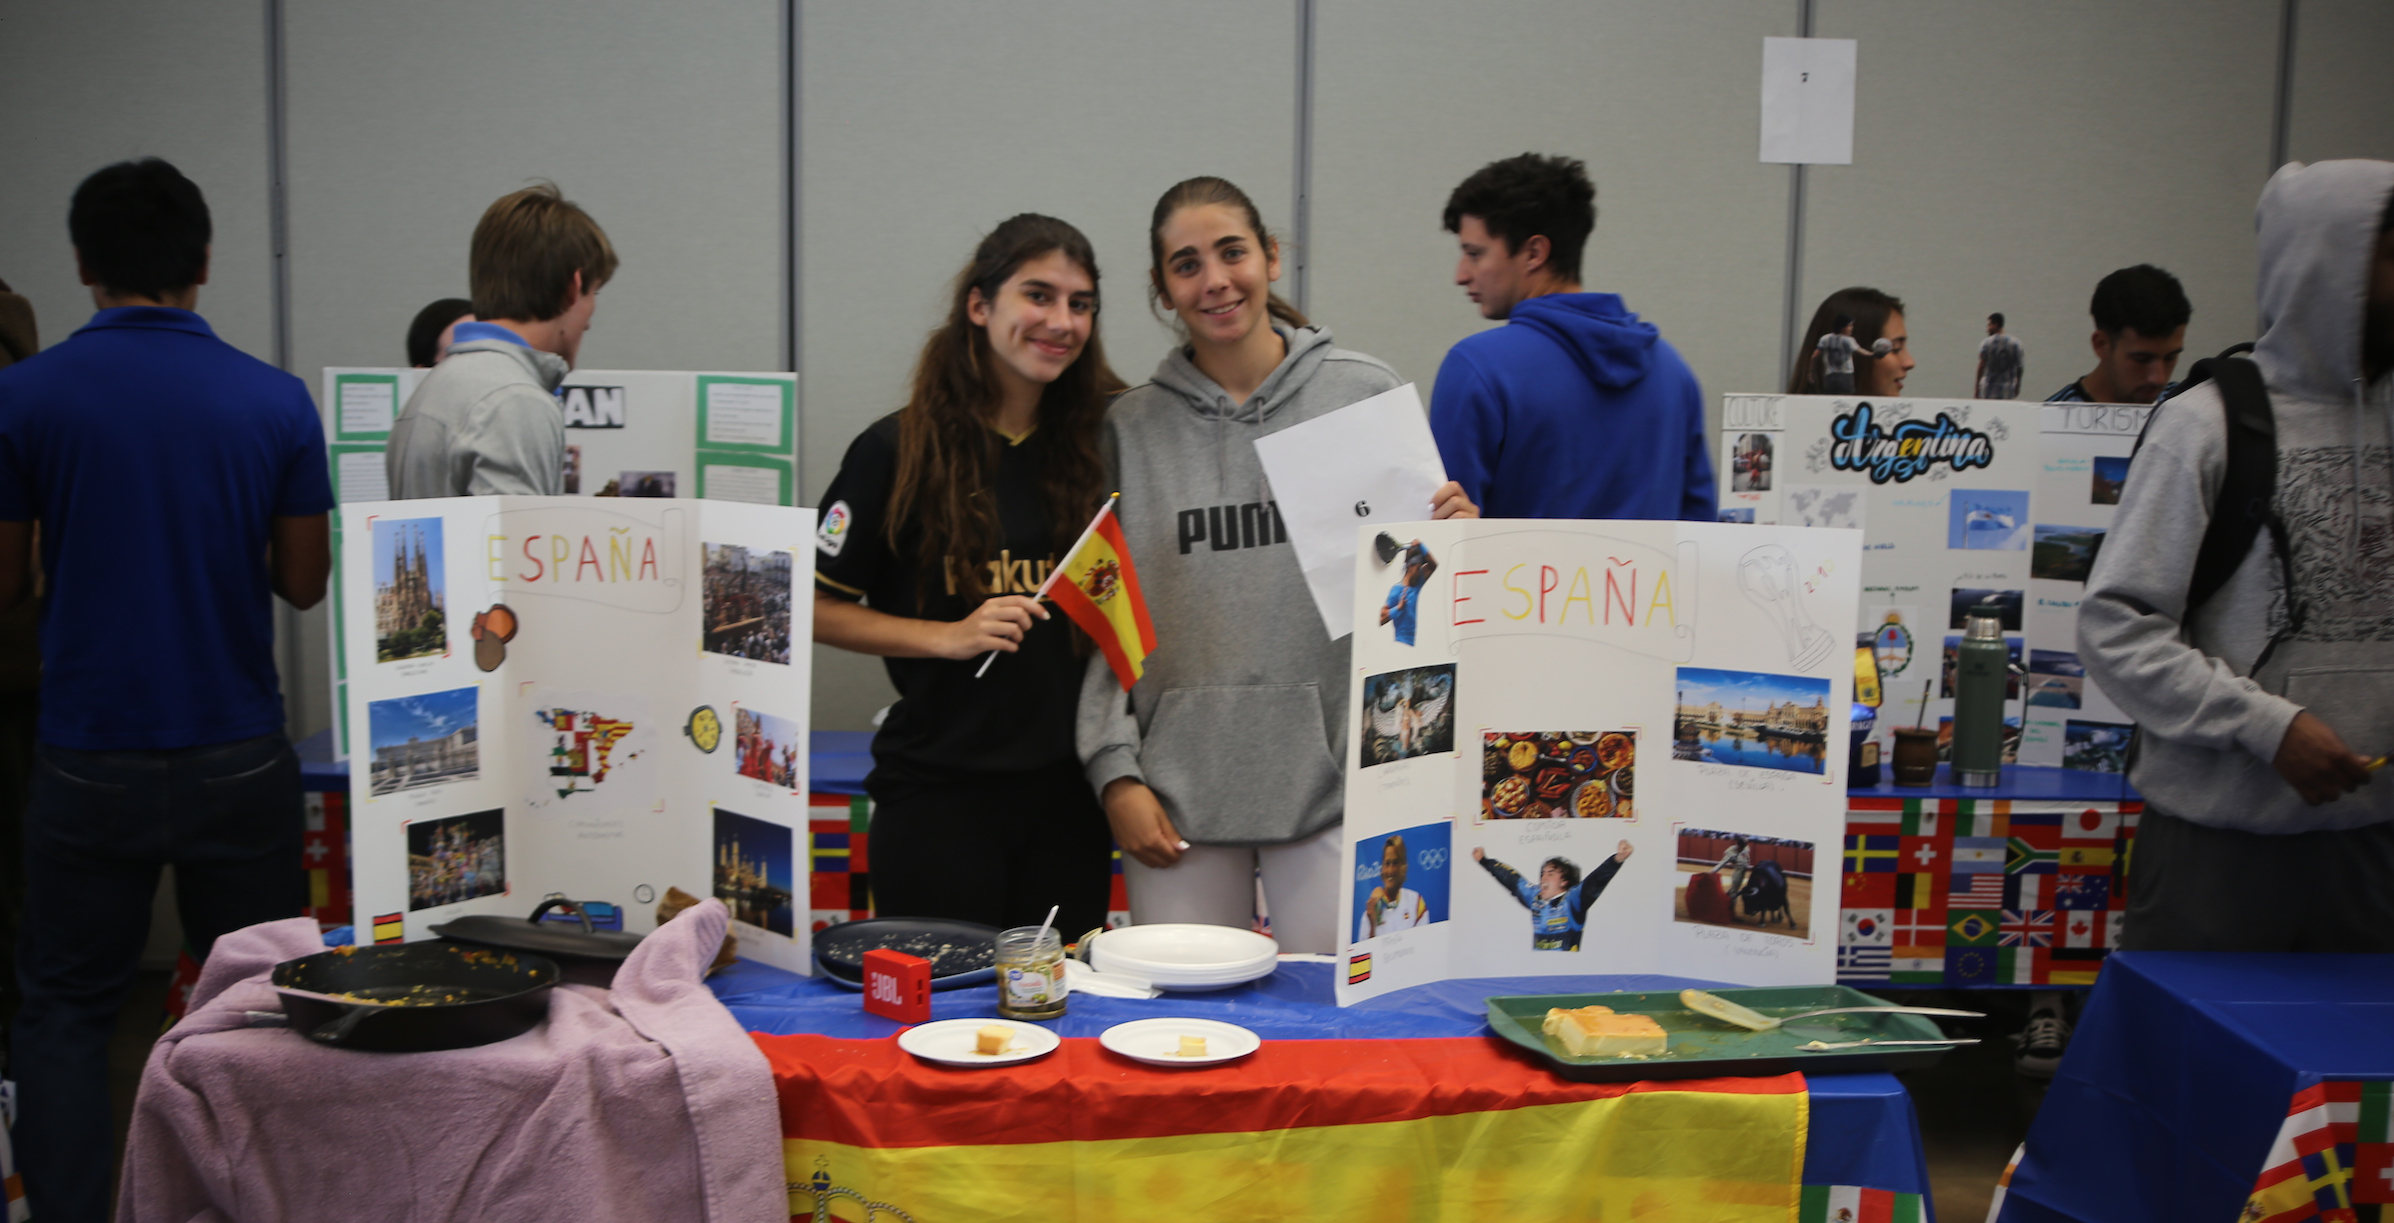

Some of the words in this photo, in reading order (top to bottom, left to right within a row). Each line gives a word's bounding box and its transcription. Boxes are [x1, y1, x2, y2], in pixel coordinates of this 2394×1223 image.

[564, 388, 624, 425] AN
[2058, 405, 2152, 432] TURISM
[1831, 402, 1994, 484] Argentina
[1178, 501, 1287, 555] PUM
[1354, 500, 1371, 517] 6
[488, 526, 659, 583] ESPAÑA
[1453, 556, 1675, 628] ESPAÑA
[871, 972, 903, 1005] JBL
